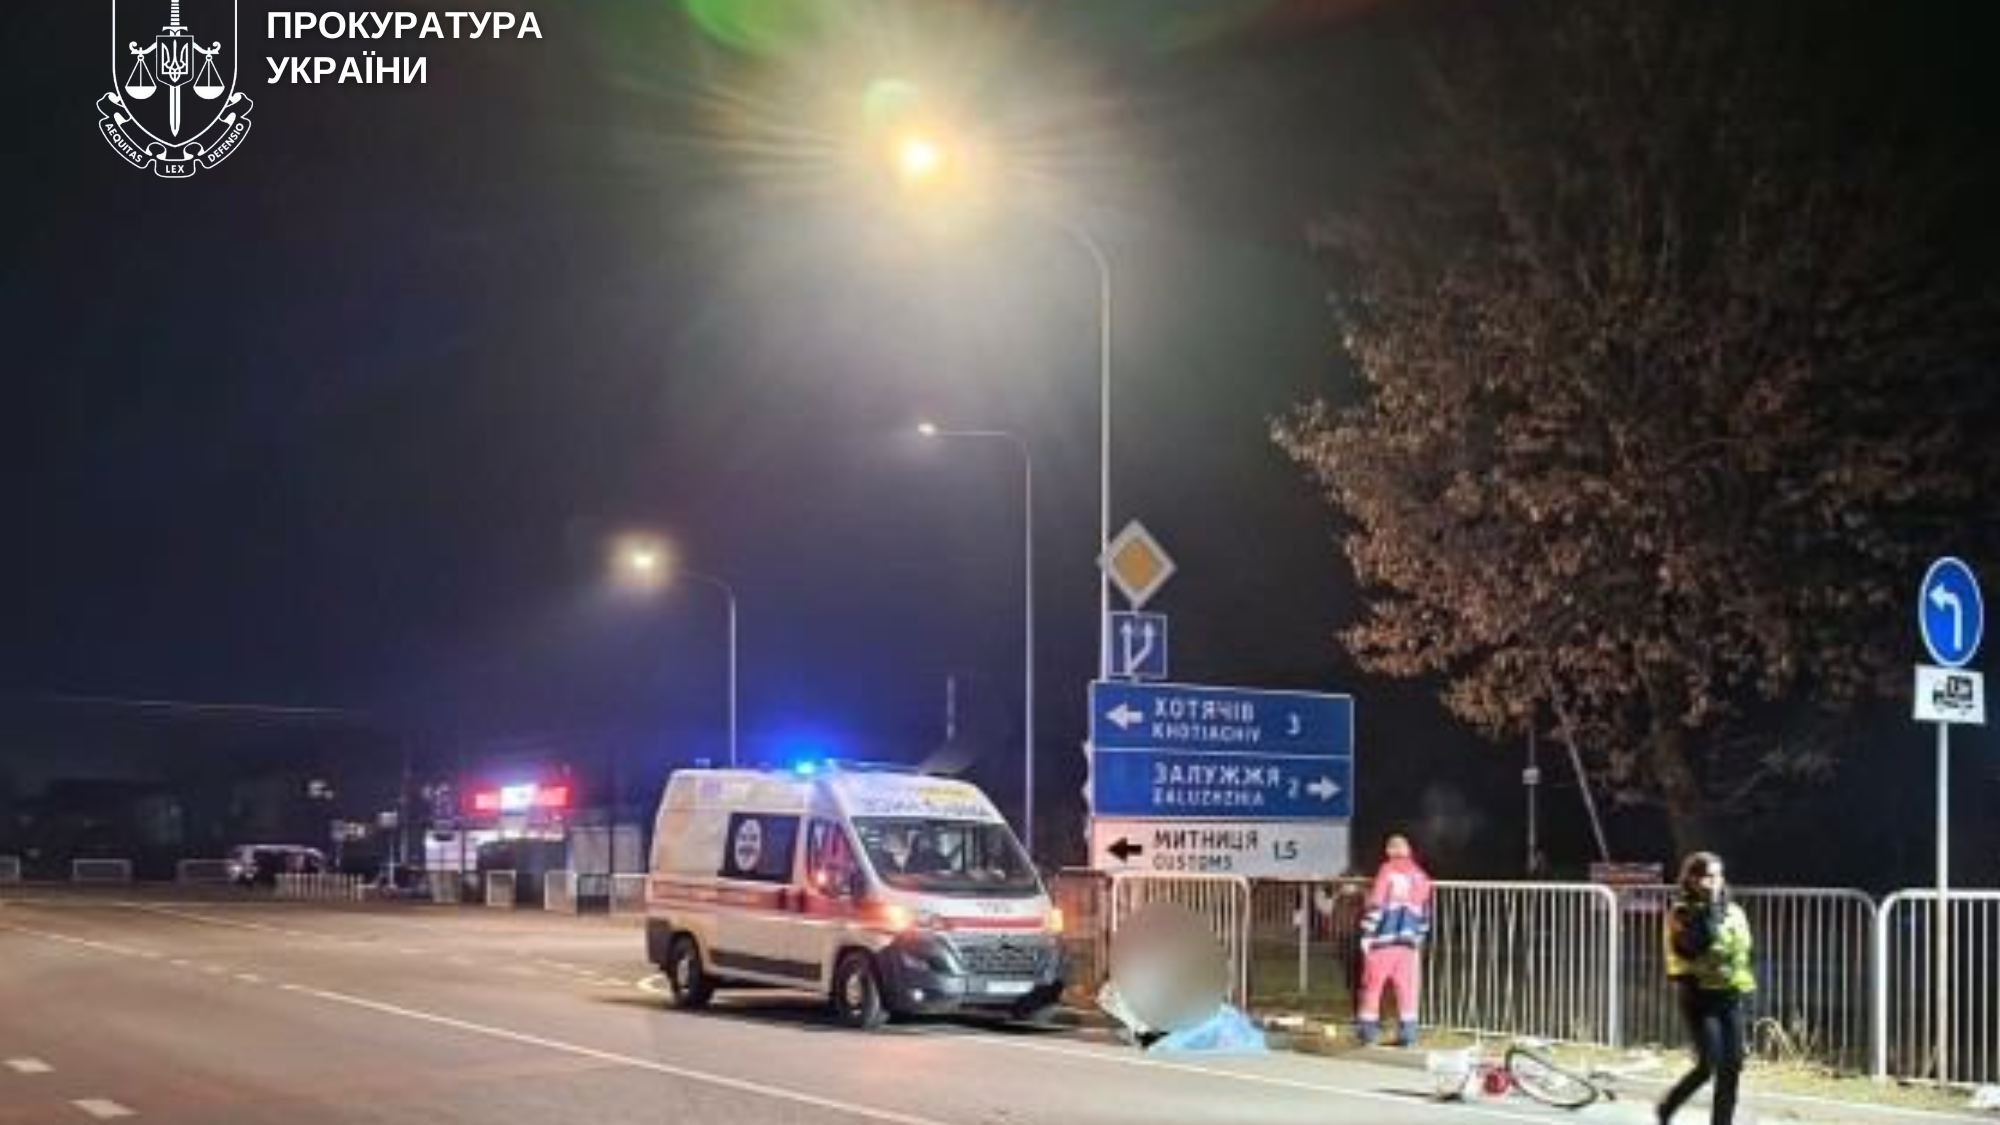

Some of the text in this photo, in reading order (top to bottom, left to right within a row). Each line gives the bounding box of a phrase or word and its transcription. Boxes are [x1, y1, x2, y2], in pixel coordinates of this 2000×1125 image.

[1154, 697, 1255, 722] ХОТЯЧІВ
[1154, 762, 1281, 788] ЗАЛУЖЖЯ
[1153, 829, 1259, 851] МИТНИЦЯ
[1153, 854, 1233, 871] CUSTOMS
